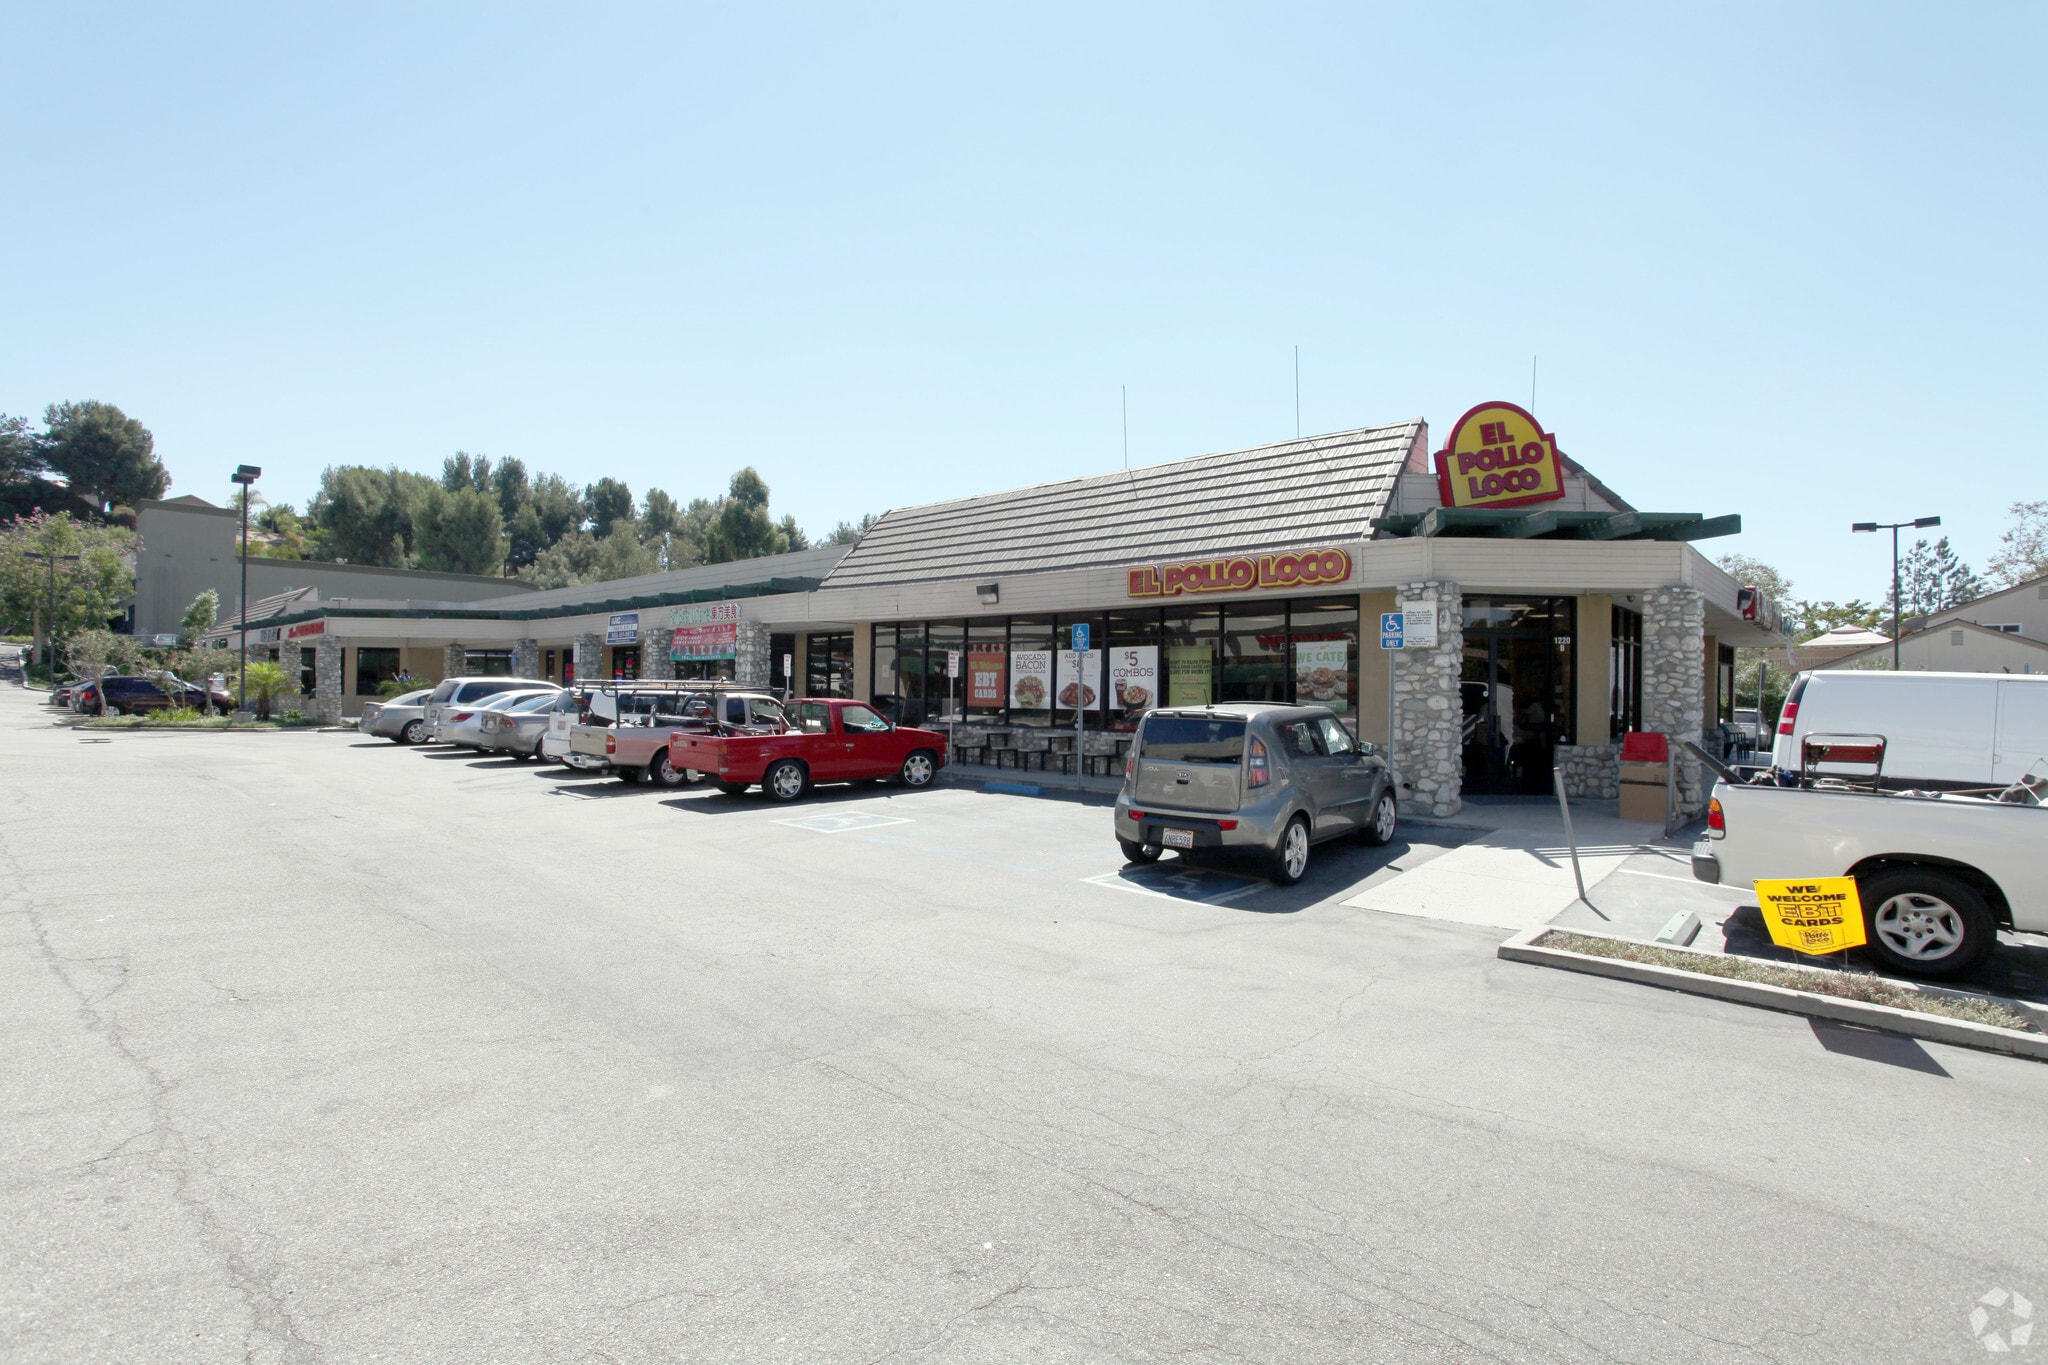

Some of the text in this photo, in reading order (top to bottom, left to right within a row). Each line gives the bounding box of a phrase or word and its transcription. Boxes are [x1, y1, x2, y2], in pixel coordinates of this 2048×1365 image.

[1480, 421, 1515, 446] EL
[1457, 441, 1545, 476] POLLO
[1468, 467, 1542, 499] LOCO
[1128, 548, 1351, 597] EL POLLO LOCO
[711, 604, 738, 620] 東方美食
[1554, 636, 1571, 644] 1220
[1124, 651, 1139, 667] $5
[1297, 652, 1313, 664] WE
[1015, 661, 1046, 669] BACON
[975, 672, 997, 687] EBT
[1113, 668, 1154, 678] COMBOS
[974, 689, 997, 698] CARDS
[1786, 885, 1817, 894] WE
[1767, 894, 1847, 903] WELCOME
[1777, 902, 1842, 918] EBT
[1781, 917, 1845, 927] CARDS
